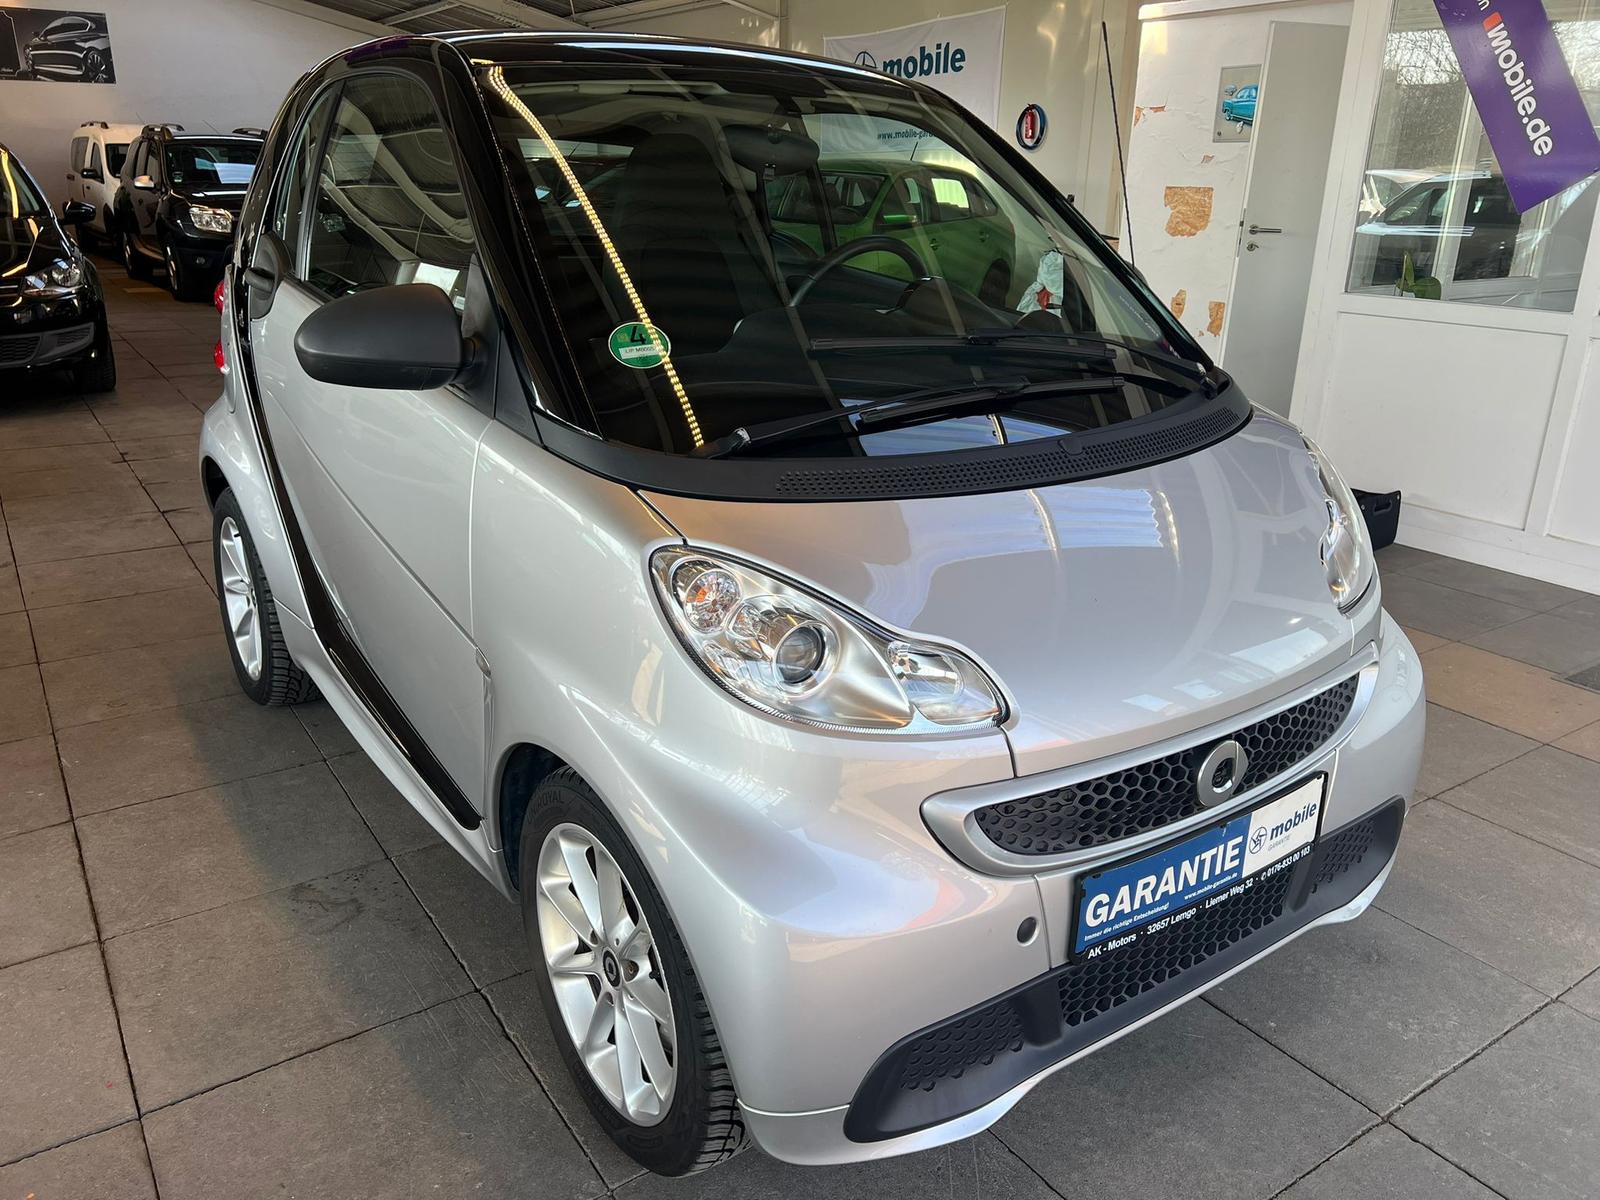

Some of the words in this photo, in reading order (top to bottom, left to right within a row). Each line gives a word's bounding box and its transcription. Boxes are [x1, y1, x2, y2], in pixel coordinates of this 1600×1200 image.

[882, 42, 966, 79] mobile
[1487, 23, 1553, 156] mobile.de
[630, 325, 646, 345] 4
[1269, 803, 1317, 841] mobile
[1085, 835, 1244, 928] GARANTIE
[1087, 945, 1102, 960] AK
[1107, 933, 1137, 951] Motors
[1146, 917, 1170, 935] 32657
[1170, 907, 1197, 925] Lemgo
[1229, 883, 1245, 897] Weg
[1245, 877, 1254, 889] 32
